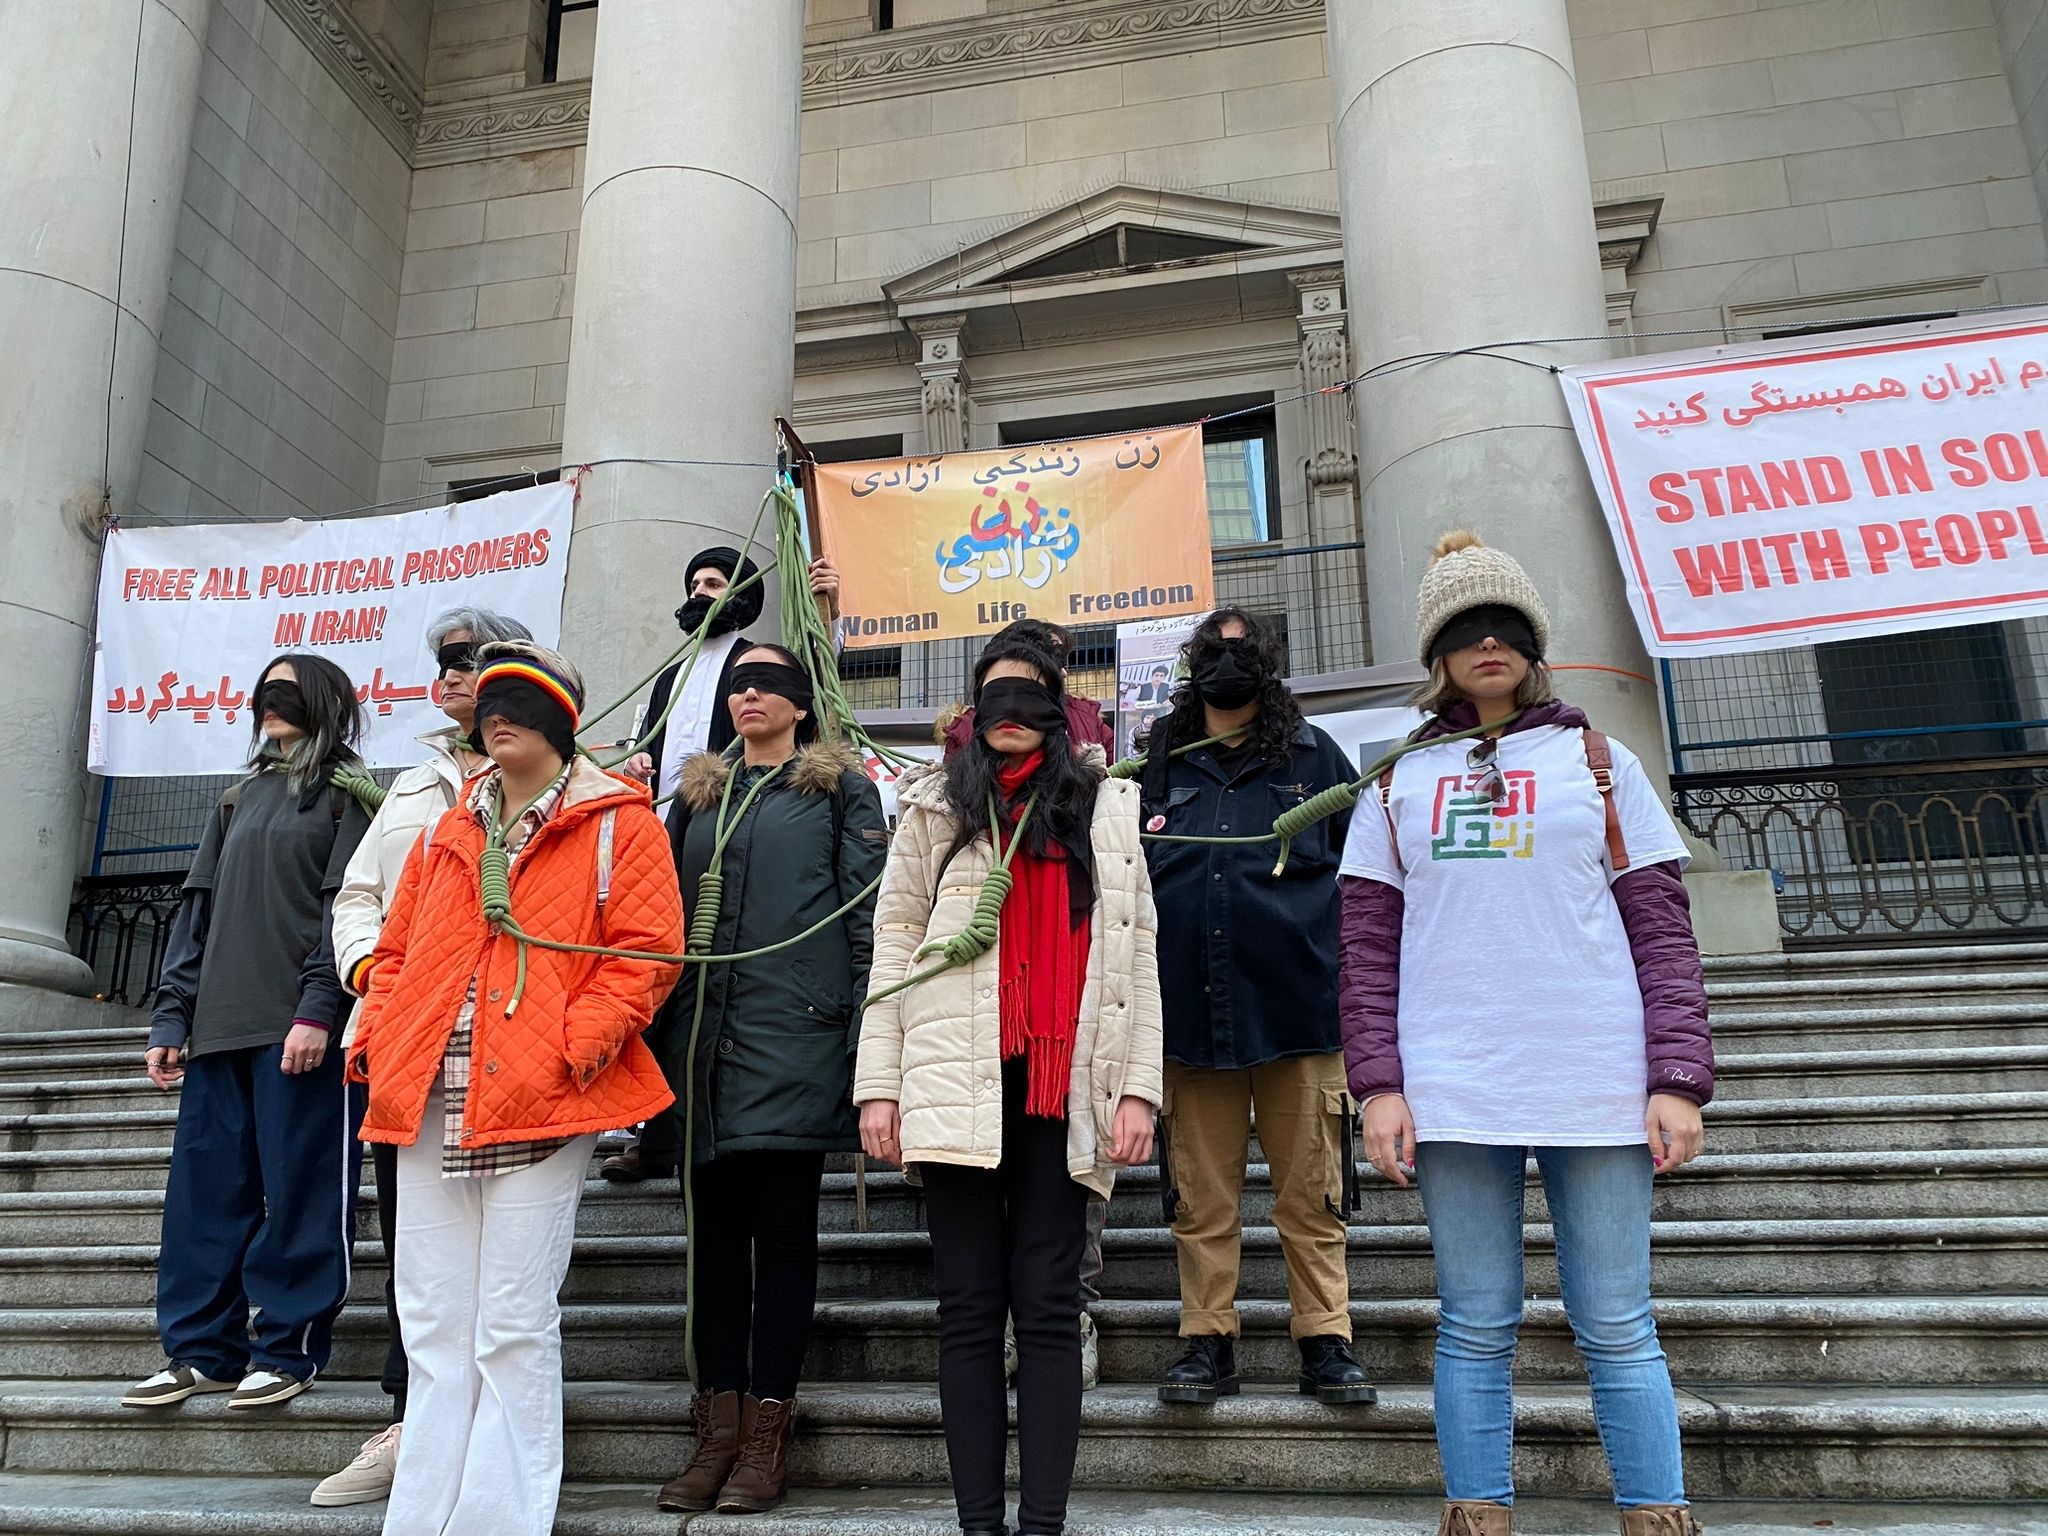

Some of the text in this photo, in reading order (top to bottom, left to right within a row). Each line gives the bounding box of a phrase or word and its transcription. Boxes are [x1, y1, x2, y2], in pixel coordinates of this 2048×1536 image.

[1724, 376, 1907, 427] همبستگی
[1921, 357, 2006, 402] ایران
[1634, 391, 1707, 435] کنید
[851, 434, 1162, 498] زن زندگی آزادی
[1649, 429, 2048, 524] STAND IN SOL
[122, 528, 550, 601] FREE ALL POLITICAL PRISONERS
[1673, 505, 2048, 599] WITH PEOPL
[274, 606, 386, 647] IN IRAN!
[842, 582, 1194, 637] Woman Life Freedom
